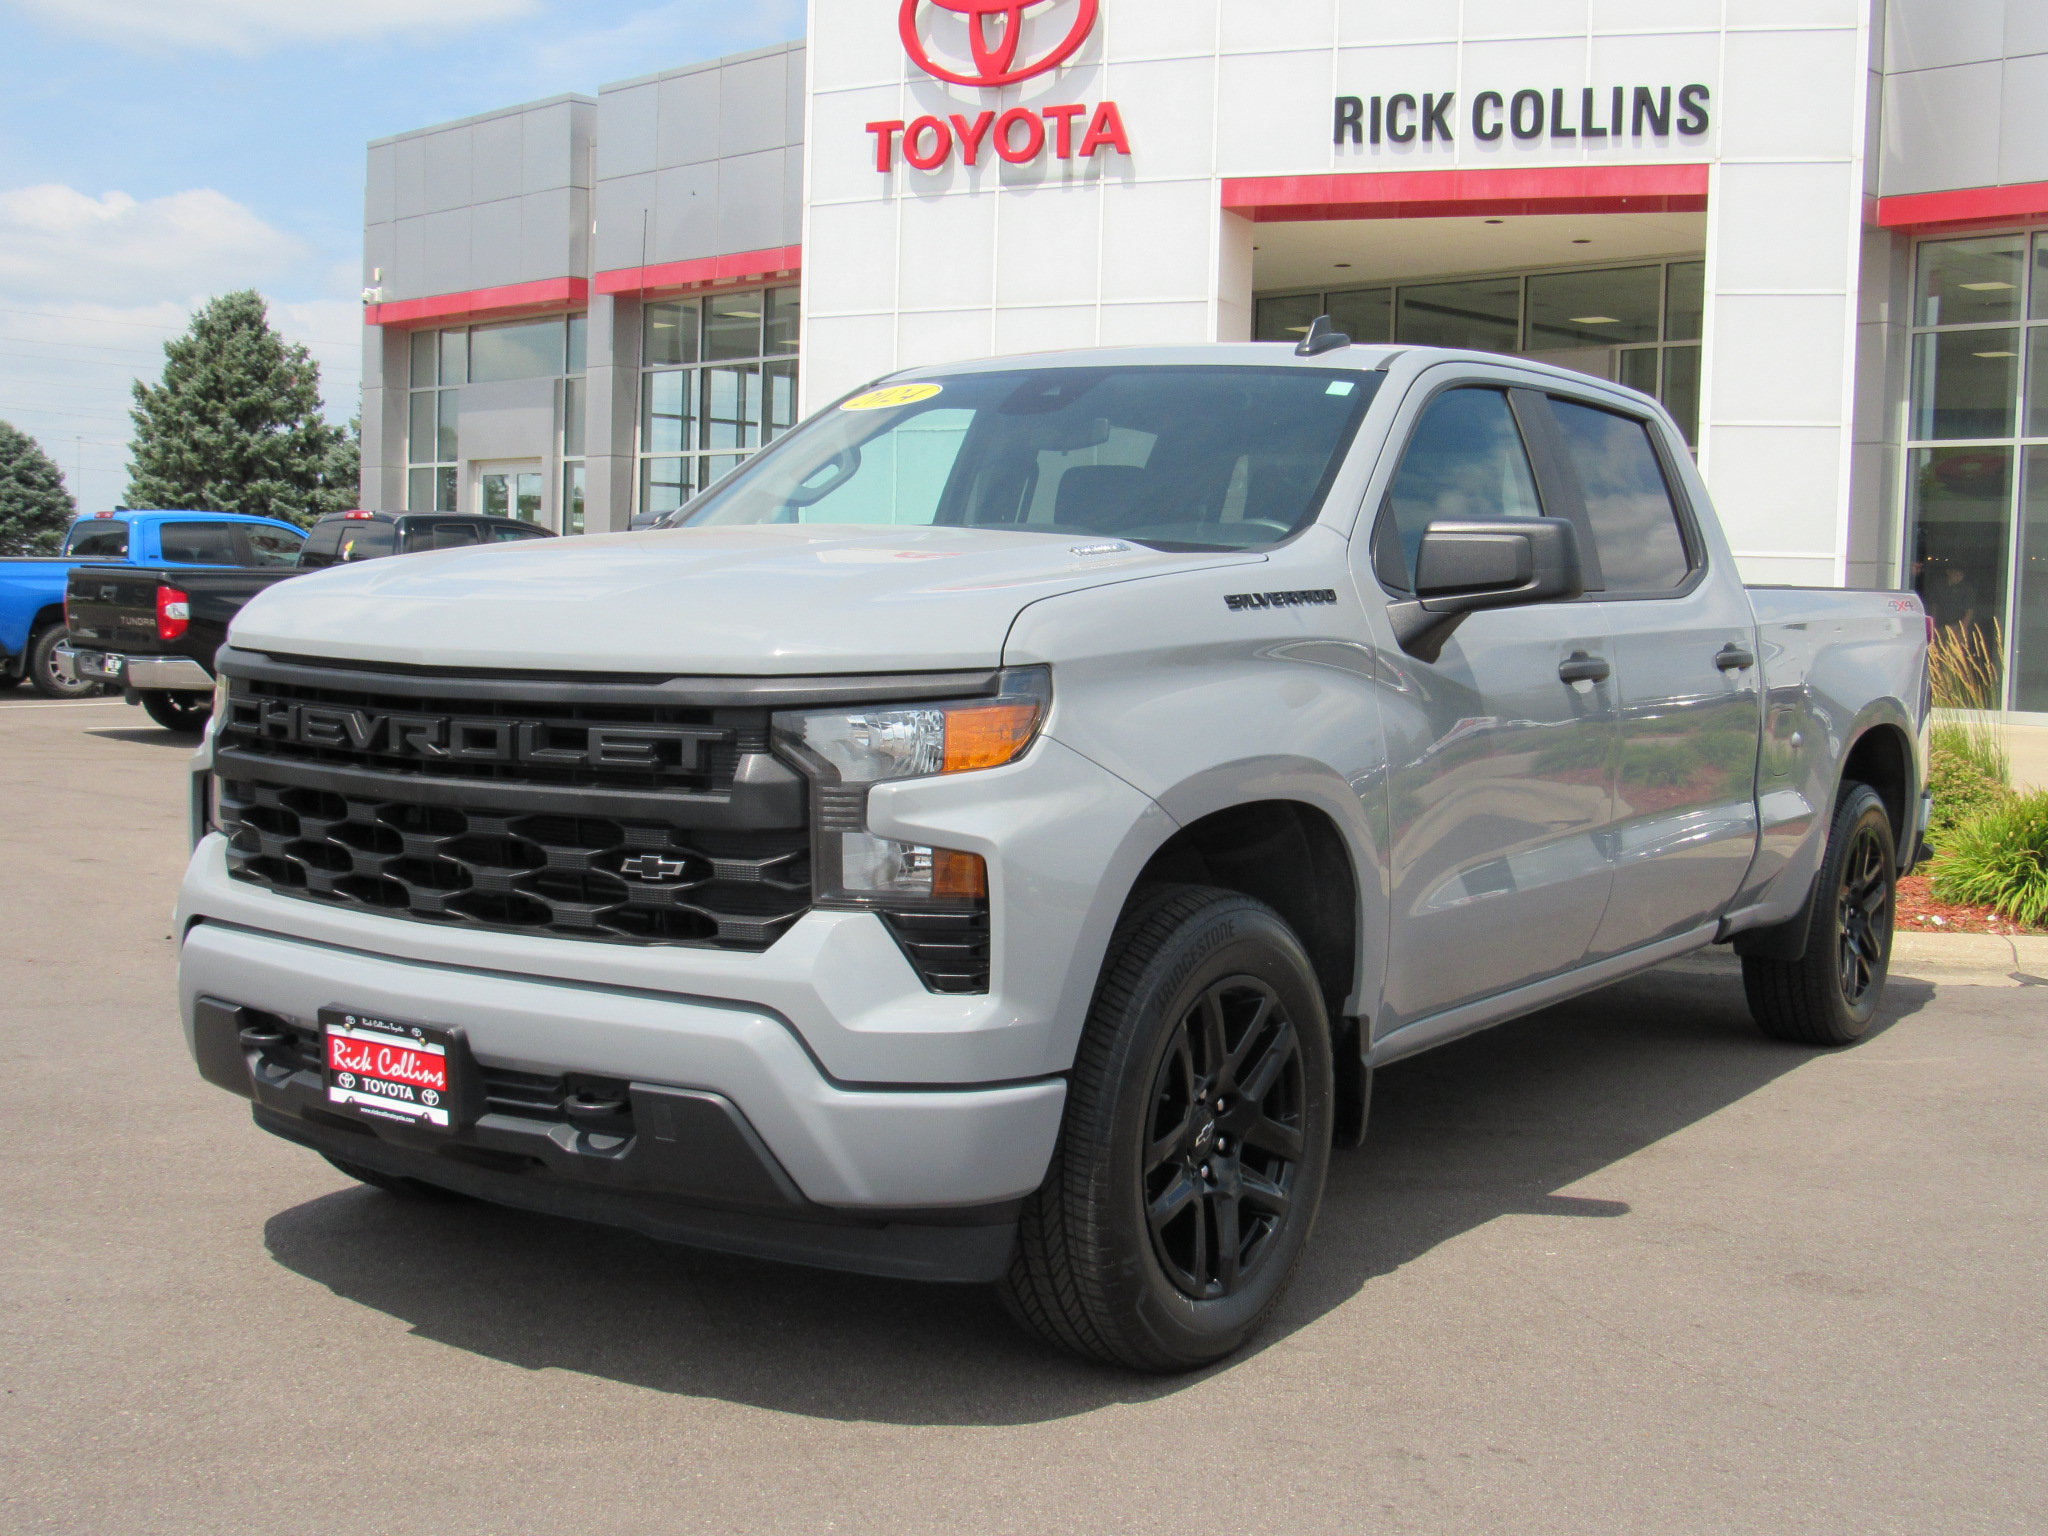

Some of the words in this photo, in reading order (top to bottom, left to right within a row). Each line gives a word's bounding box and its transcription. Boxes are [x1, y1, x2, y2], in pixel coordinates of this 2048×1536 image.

[866, 101, 1131, 172] TOYOTA
[1333, 92, 1455, 144] RICK
[1472, 84, 1710, 142] COLLINS
[120, 616, 156, 627] TUNDRA
[1224, 589, 1338, 610] SILVERADO
[228, 698, 736, 771] CHEVROLET
[333, 1039, 372, 1072] Rick
[378, 1048, 444, 1086] Collins
[362, 1077, 414, 1100] TOYOTA
